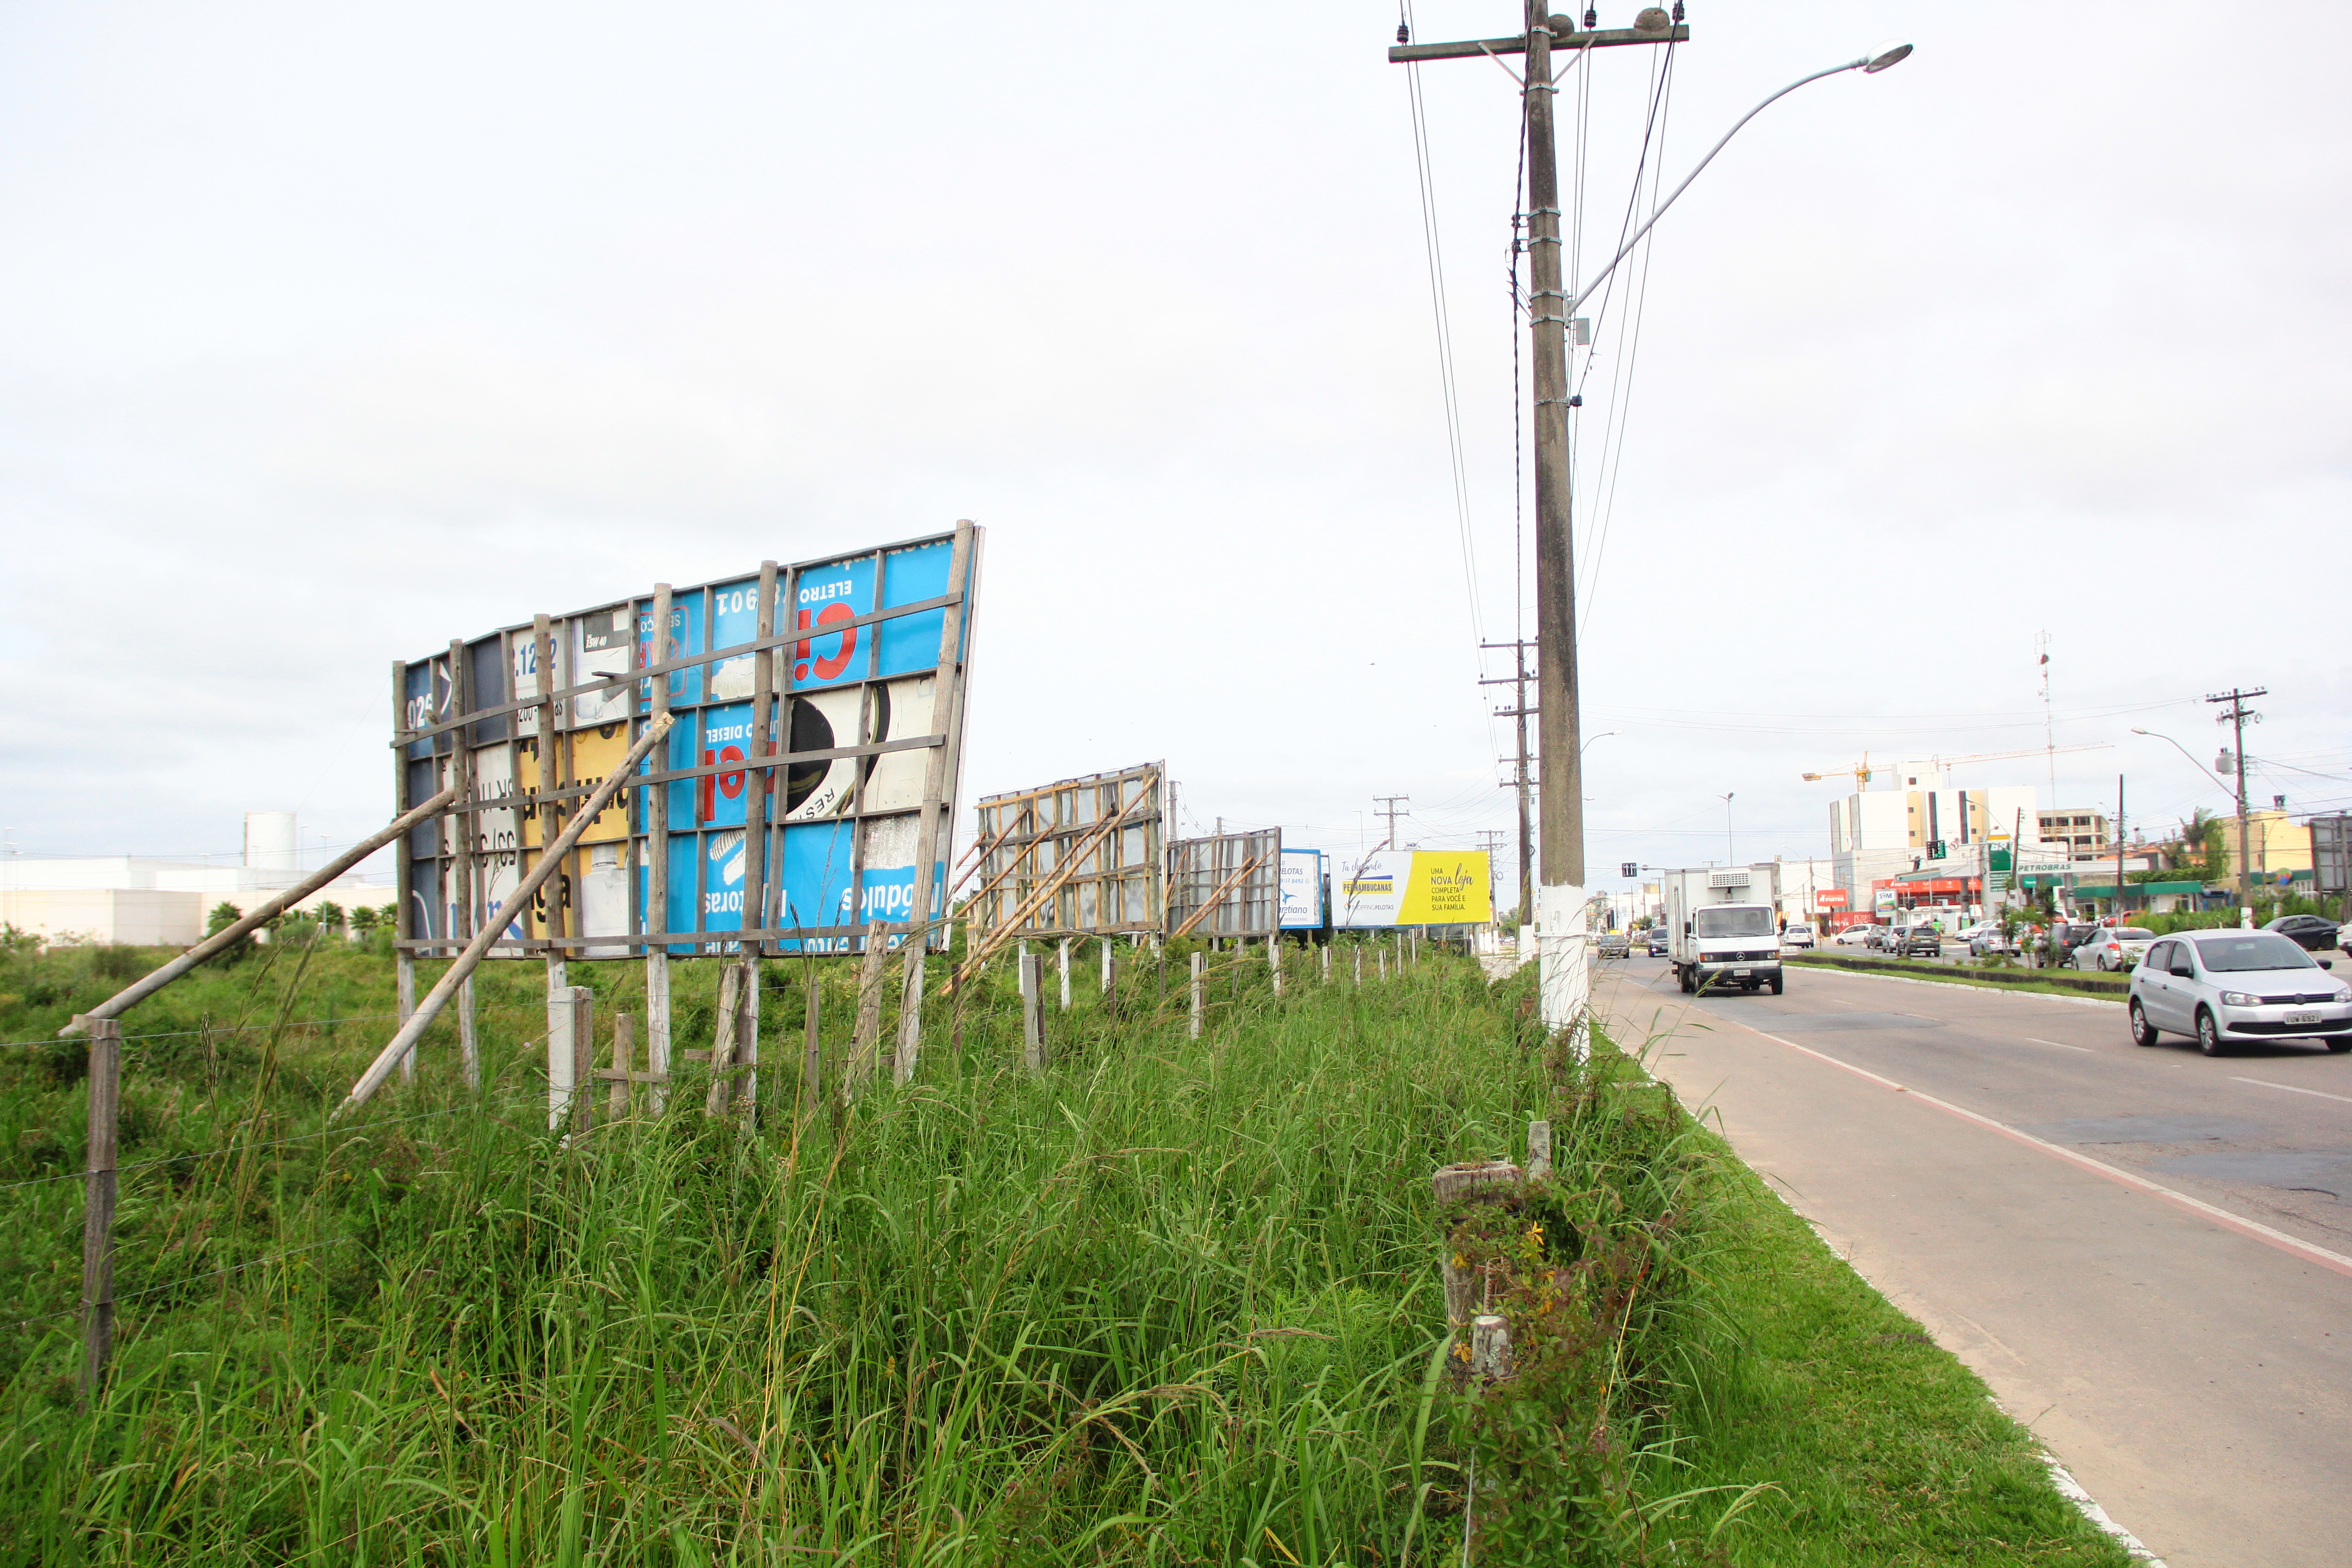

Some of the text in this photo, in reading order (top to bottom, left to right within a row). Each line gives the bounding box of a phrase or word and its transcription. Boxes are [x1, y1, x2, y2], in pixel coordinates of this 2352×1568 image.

[800, 580, 852, 603] ELETRO
[706, 725, 743, 743] DIESEL
[1431, 862, 1474, 891] NOVA loja
